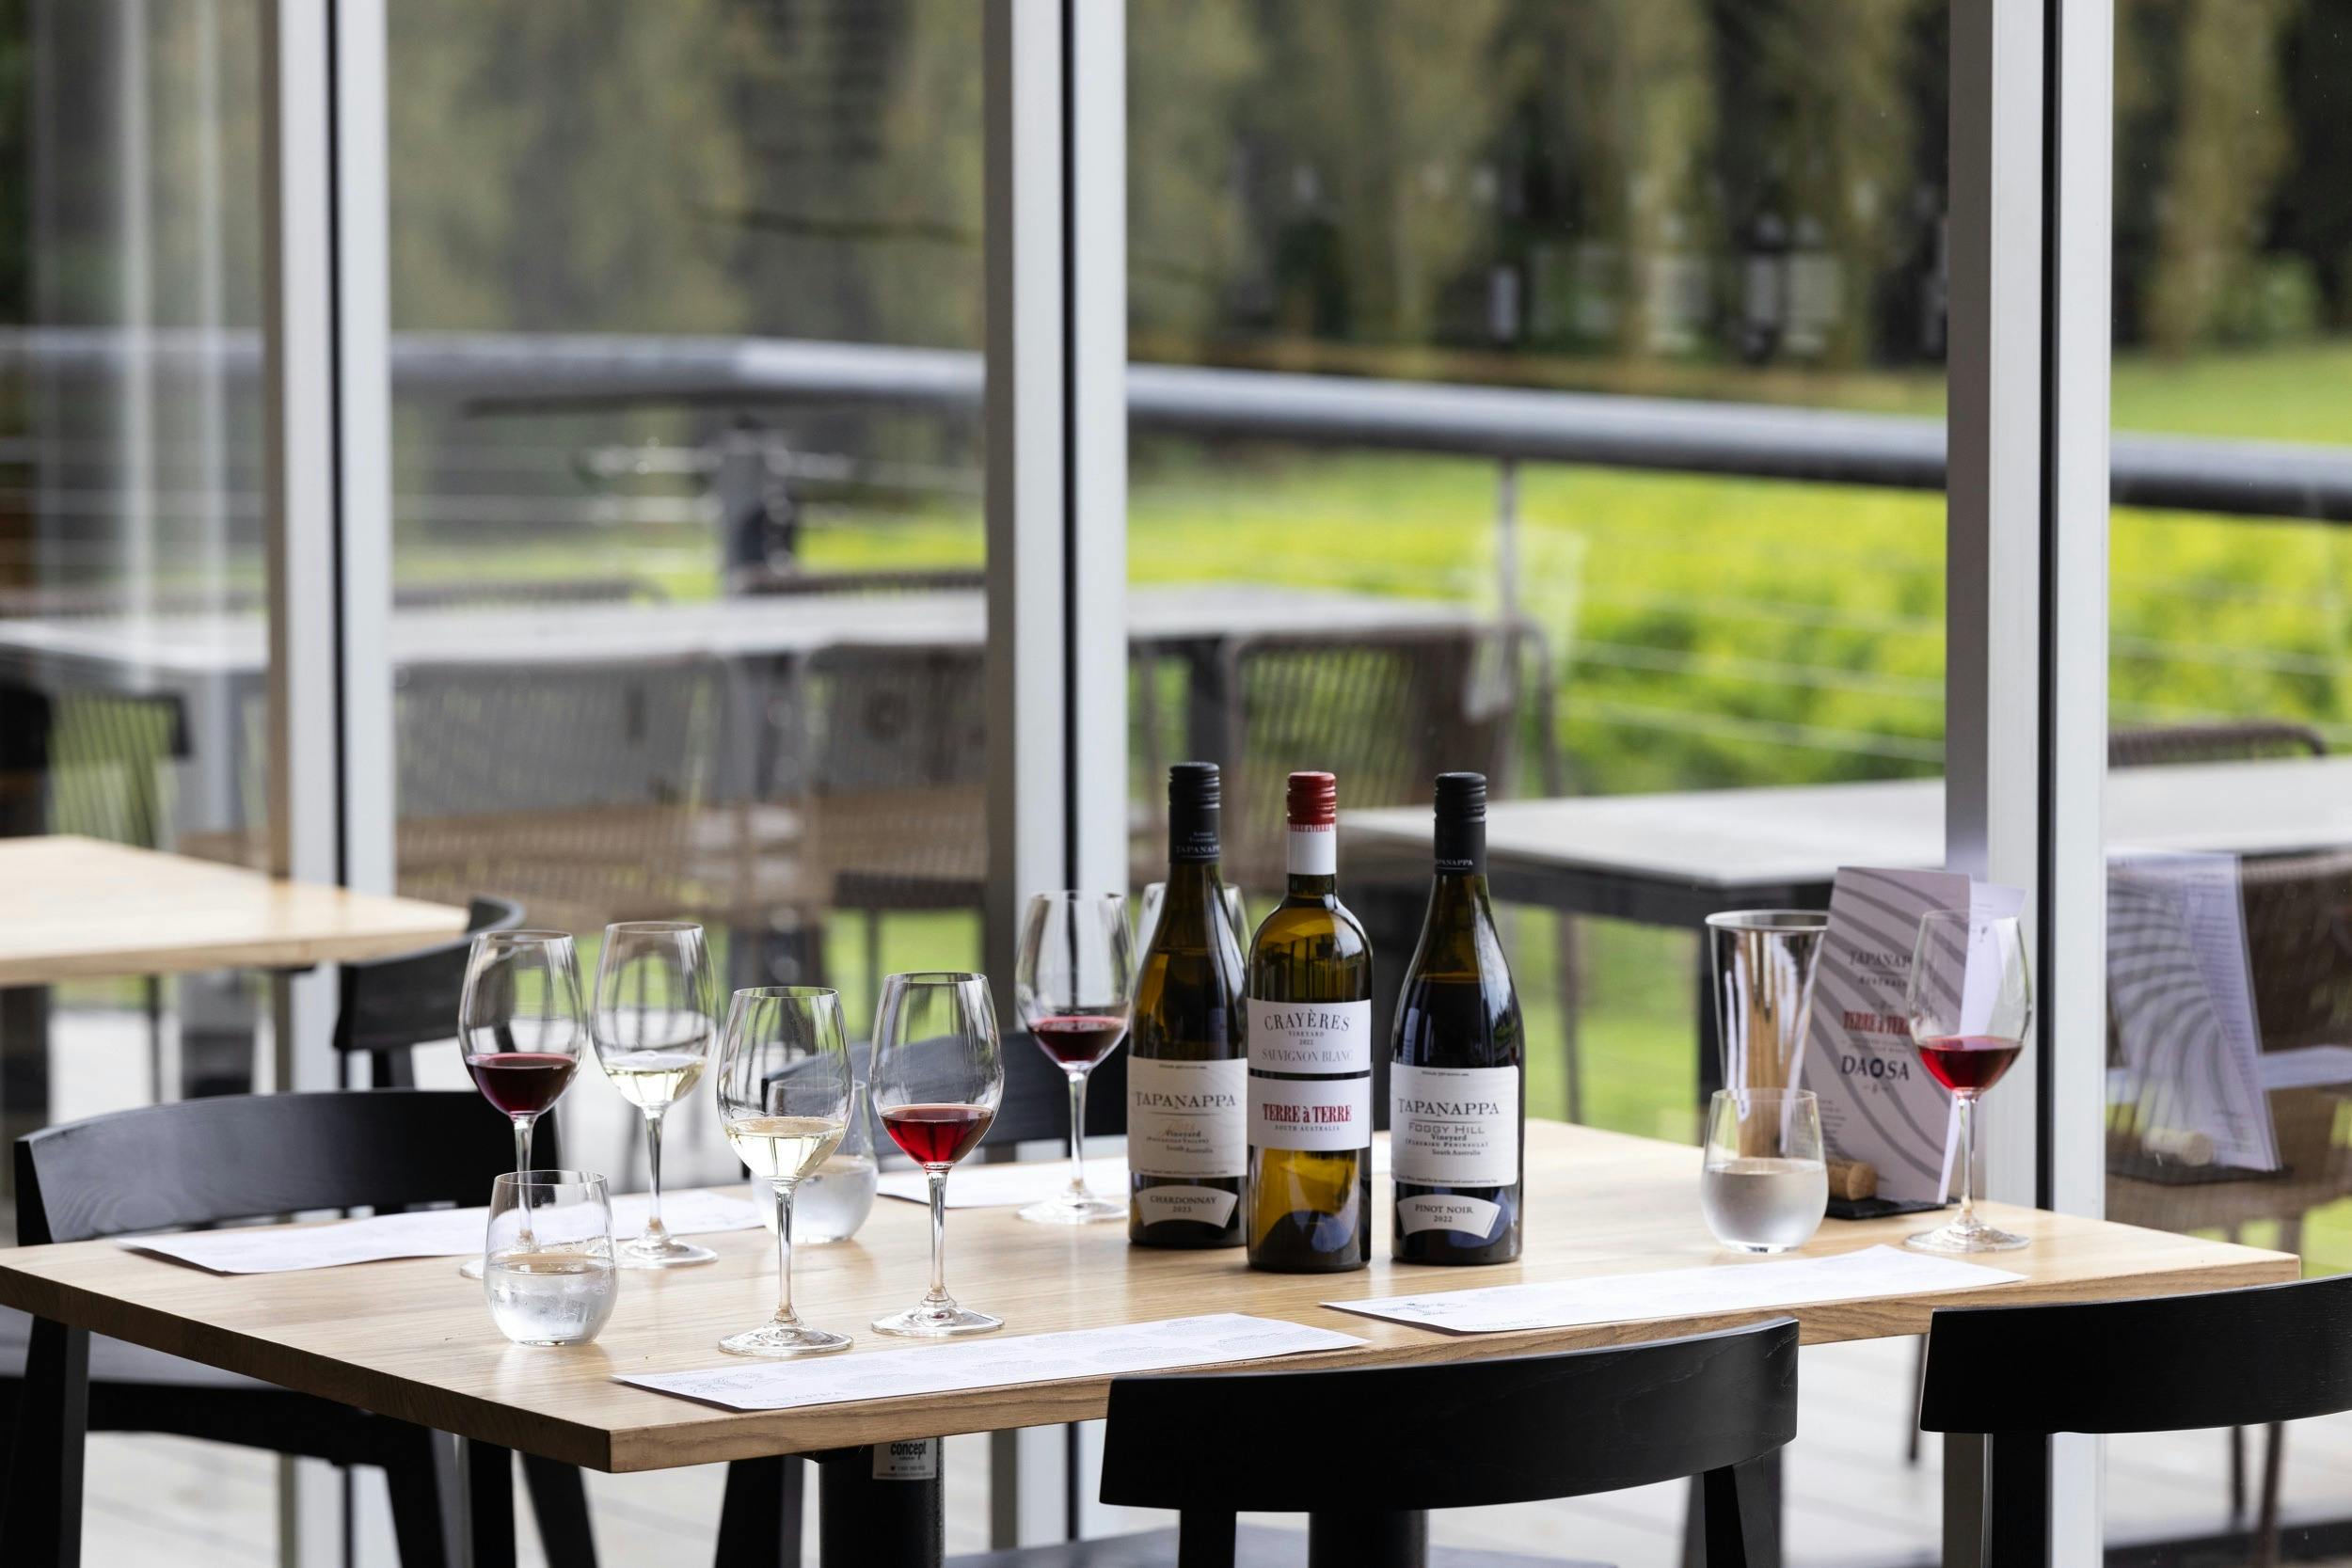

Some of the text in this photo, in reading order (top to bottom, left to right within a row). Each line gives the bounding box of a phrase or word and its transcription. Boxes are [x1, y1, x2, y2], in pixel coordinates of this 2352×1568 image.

[1264, 1009, 1350, 1031] CRAYÈRES
[1262, 1049, 1354, 1063] SAUVIGNON BLANC
[1842, 1054, 1909, 1081] DAOSA
[1136, 1092, 1236, 1109] TAPANAPPA
[1398, 1099, 1500, 1117] TAPANAPPA
[1263, 1102, 1352, 1123] TERRE à TERRE
[1408, 1122, 1485, 1134] FOGGY HILL
[1431, 1133, 1467, 1142] Vineyard
[1150, 1196, 1218, 1205] CHARDONNAY
[1415, 1204, 1474, 1214] PINOT NOIR
[1433, 1214, 1453, 1223] 2022
[890, 1440, 927, 1460] concept
